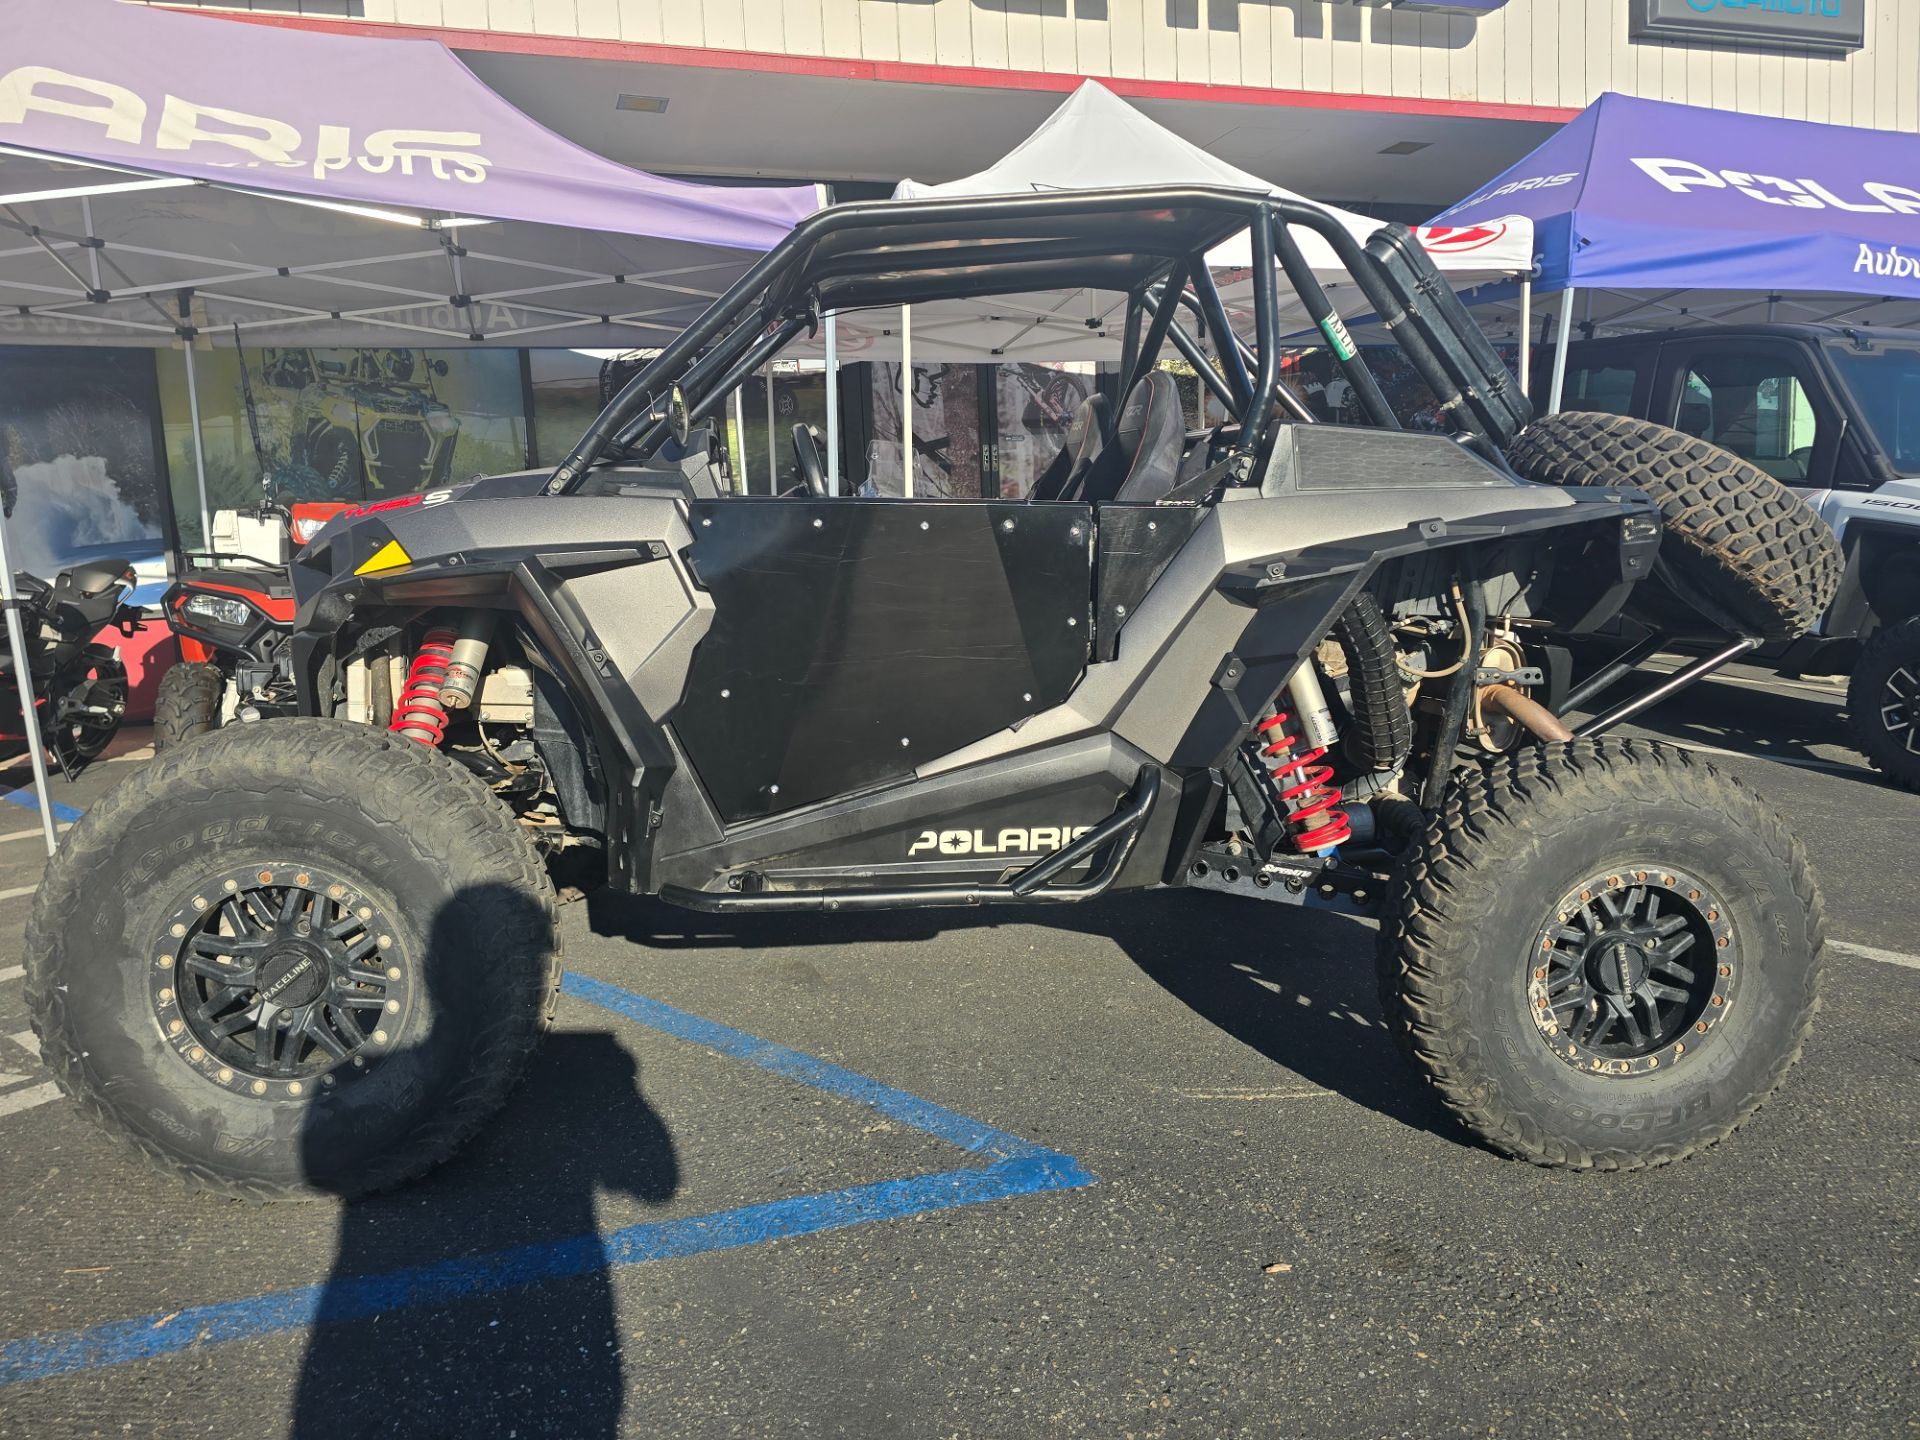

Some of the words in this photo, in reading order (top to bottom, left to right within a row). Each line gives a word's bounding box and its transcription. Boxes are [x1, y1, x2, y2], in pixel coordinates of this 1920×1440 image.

[421, 489, 453, 505] S
[262, 958, 312, 1001] RACELINE
[1617, 942, 1633, 995] RACELINE
